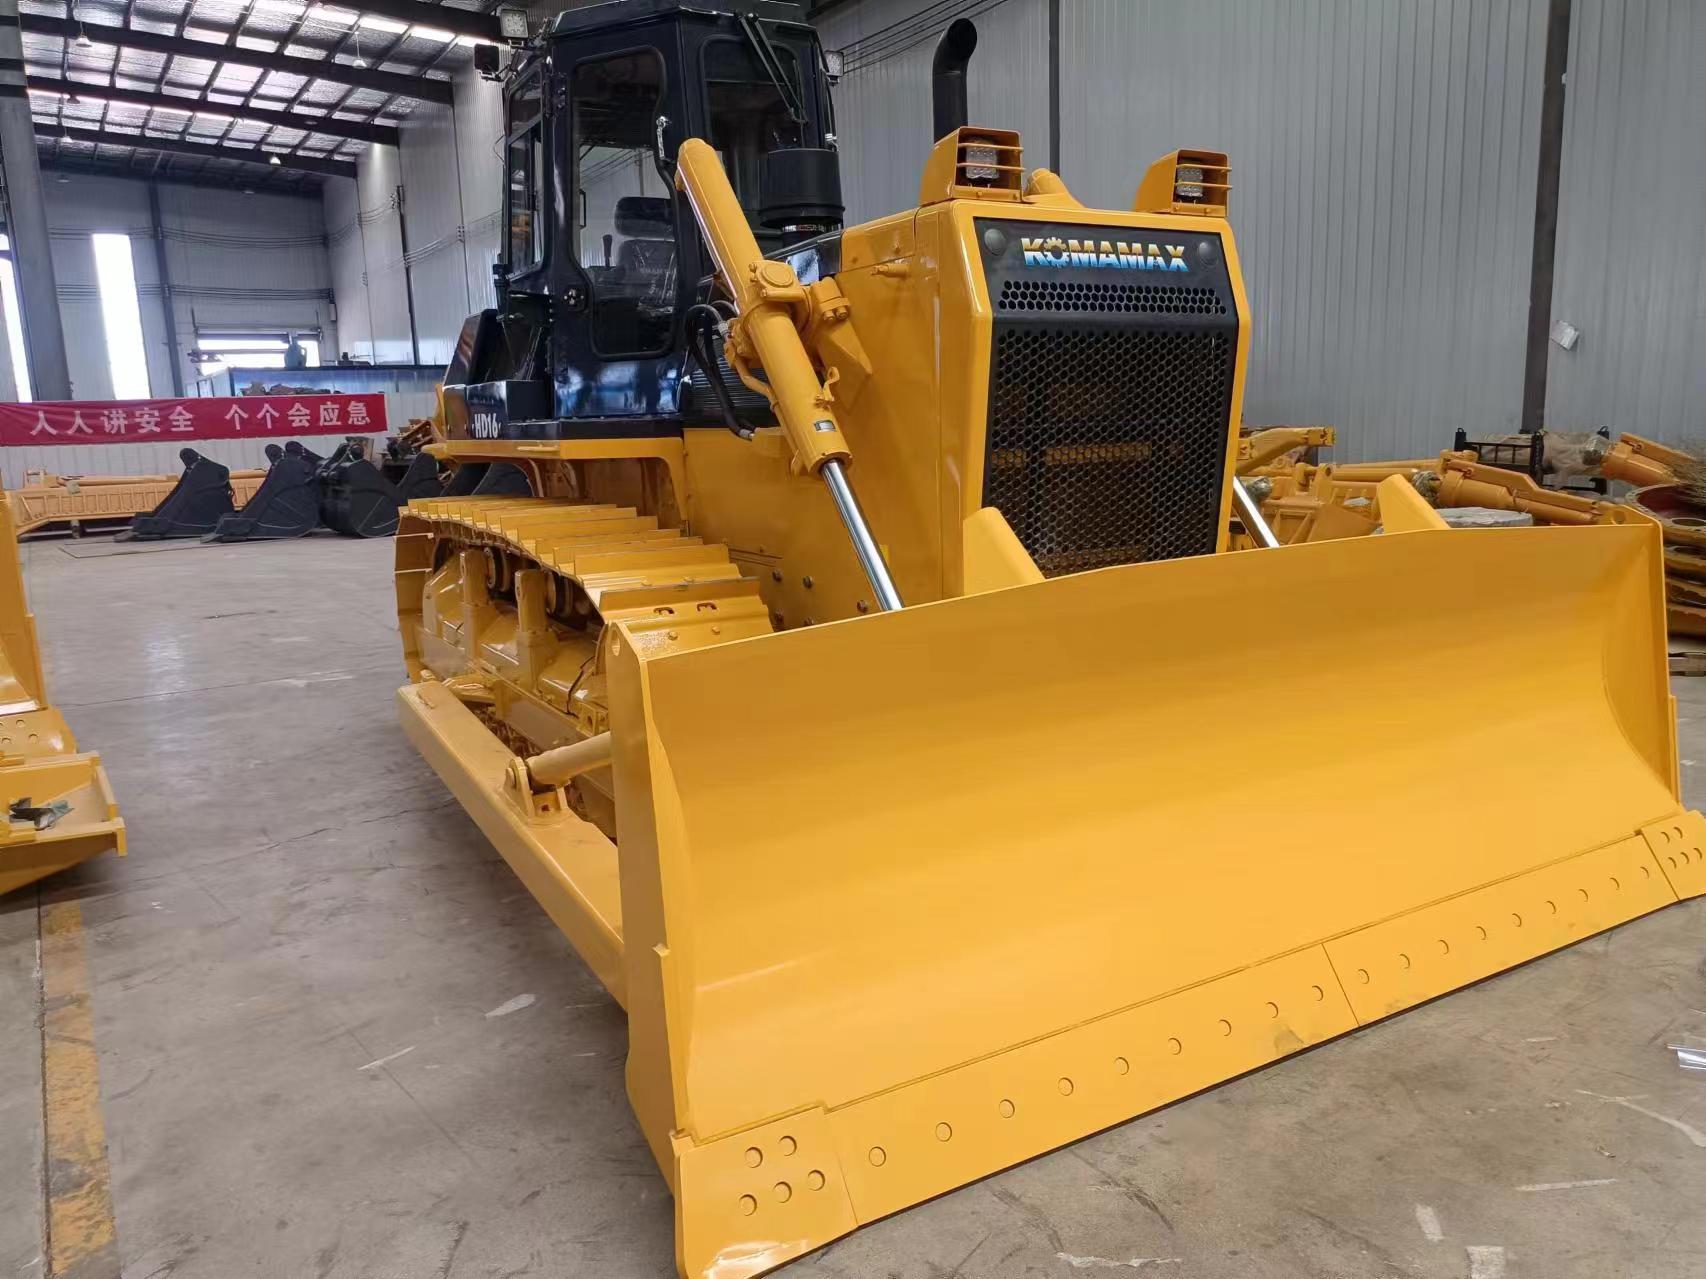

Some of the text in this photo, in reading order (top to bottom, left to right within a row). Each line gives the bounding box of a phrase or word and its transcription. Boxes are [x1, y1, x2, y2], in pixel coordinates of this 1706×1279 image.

[1021, 236, 1189, 272] KOMAMAX
[29, 400, 371, 436] 人人讲安全 个个会应急
[474, 413, 498, 438] HD16
